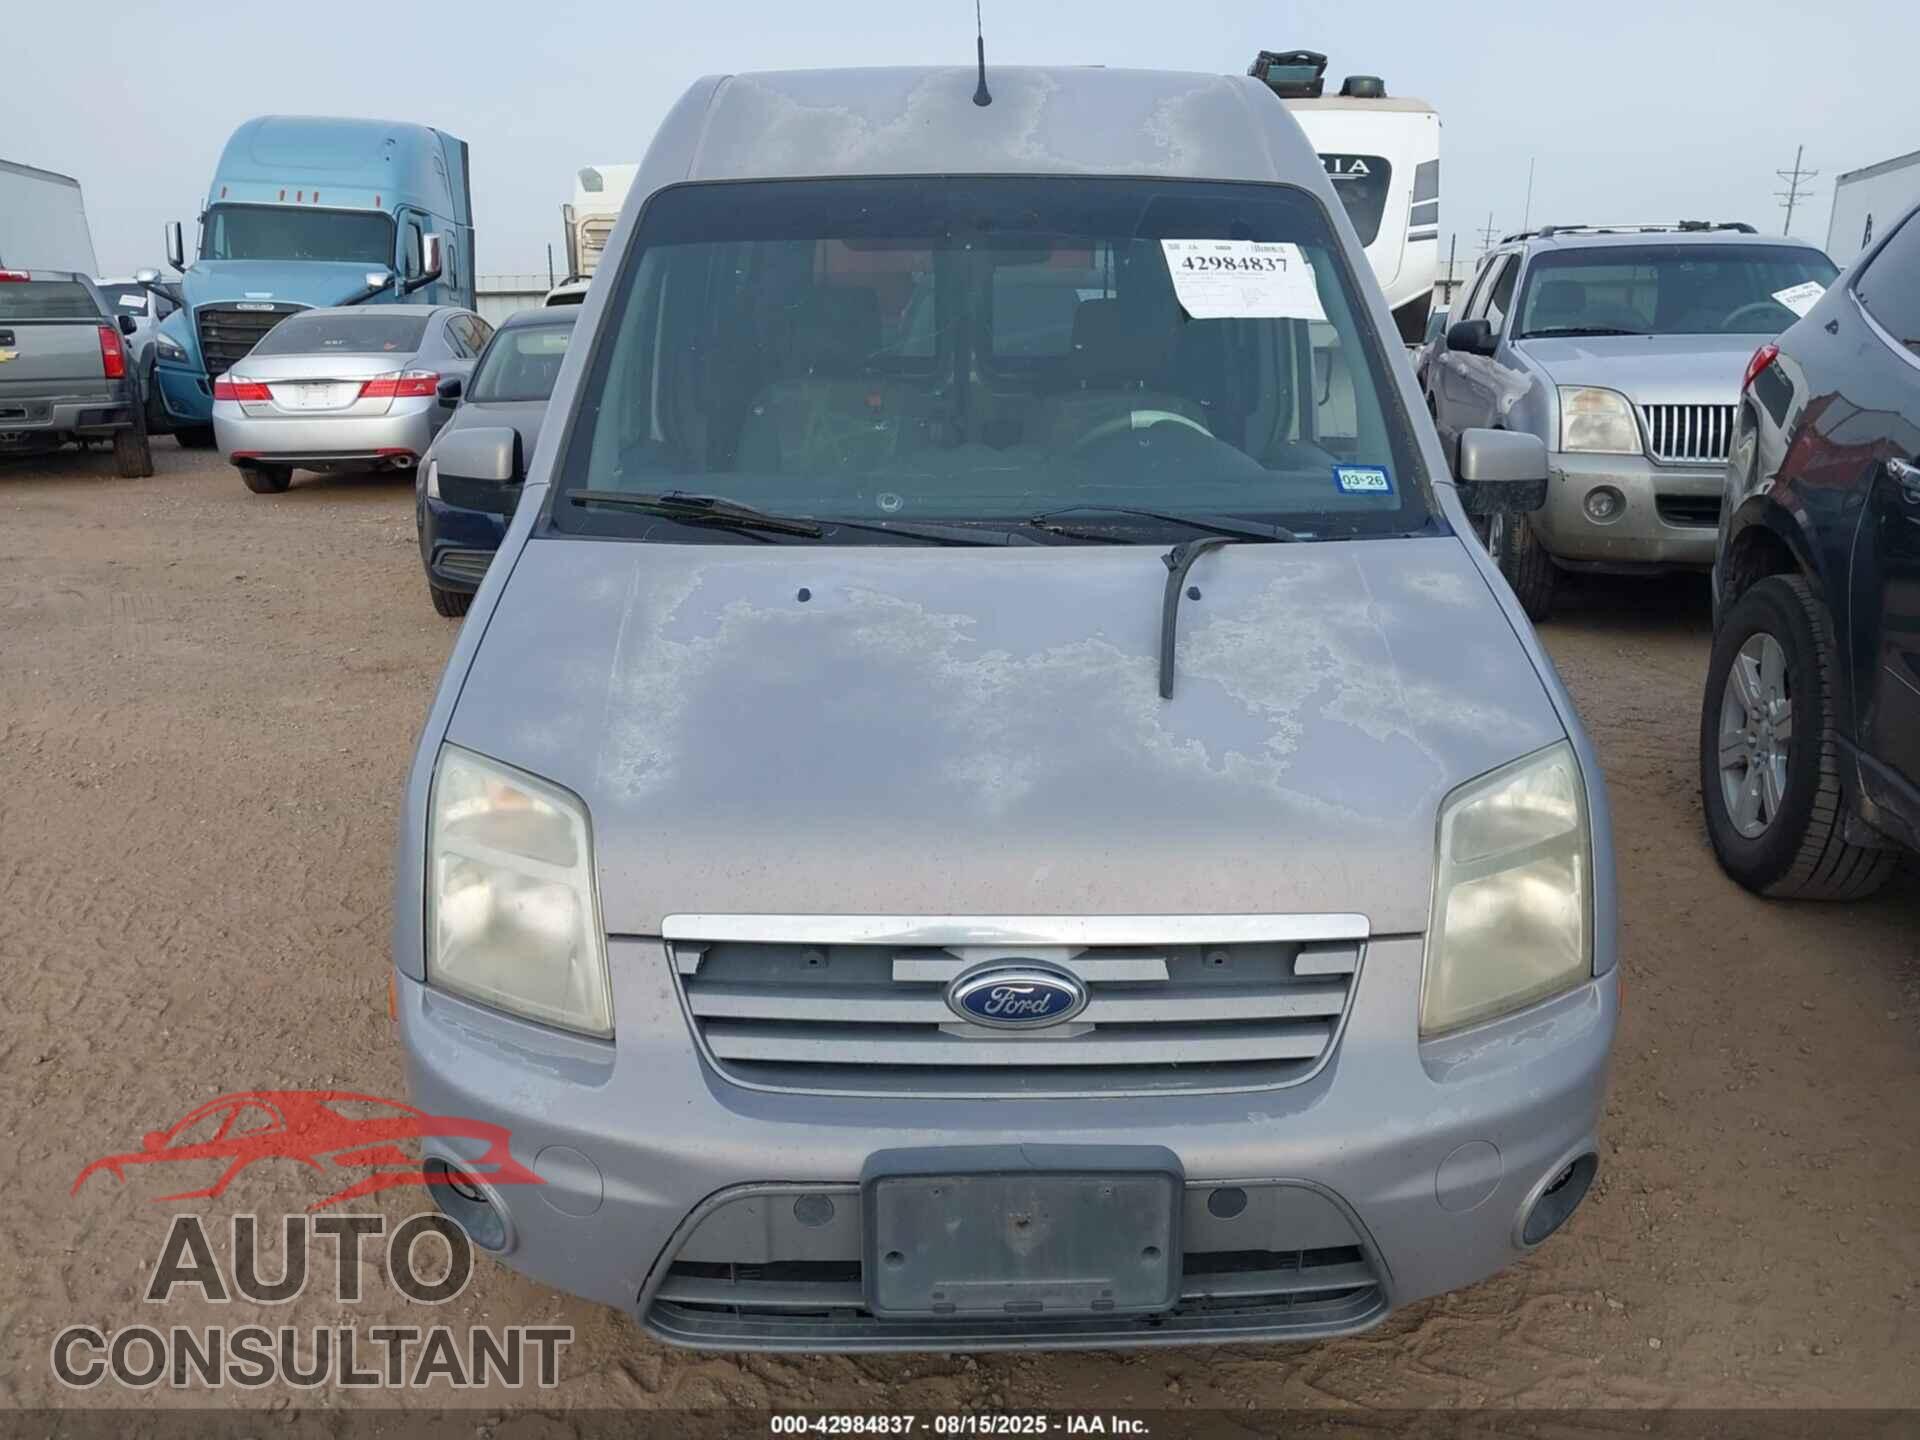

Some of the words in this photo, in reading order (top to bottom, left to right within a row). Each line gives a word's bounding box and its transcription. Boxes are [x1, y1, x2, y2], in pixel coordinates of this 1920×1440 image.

[1320, 158, 1371, 173] IA
[1182, 256, 1287, 273] 42984837
[1342, 474, 1384, 486] 03-26
[984, 986, 1052, 1014] Ford
